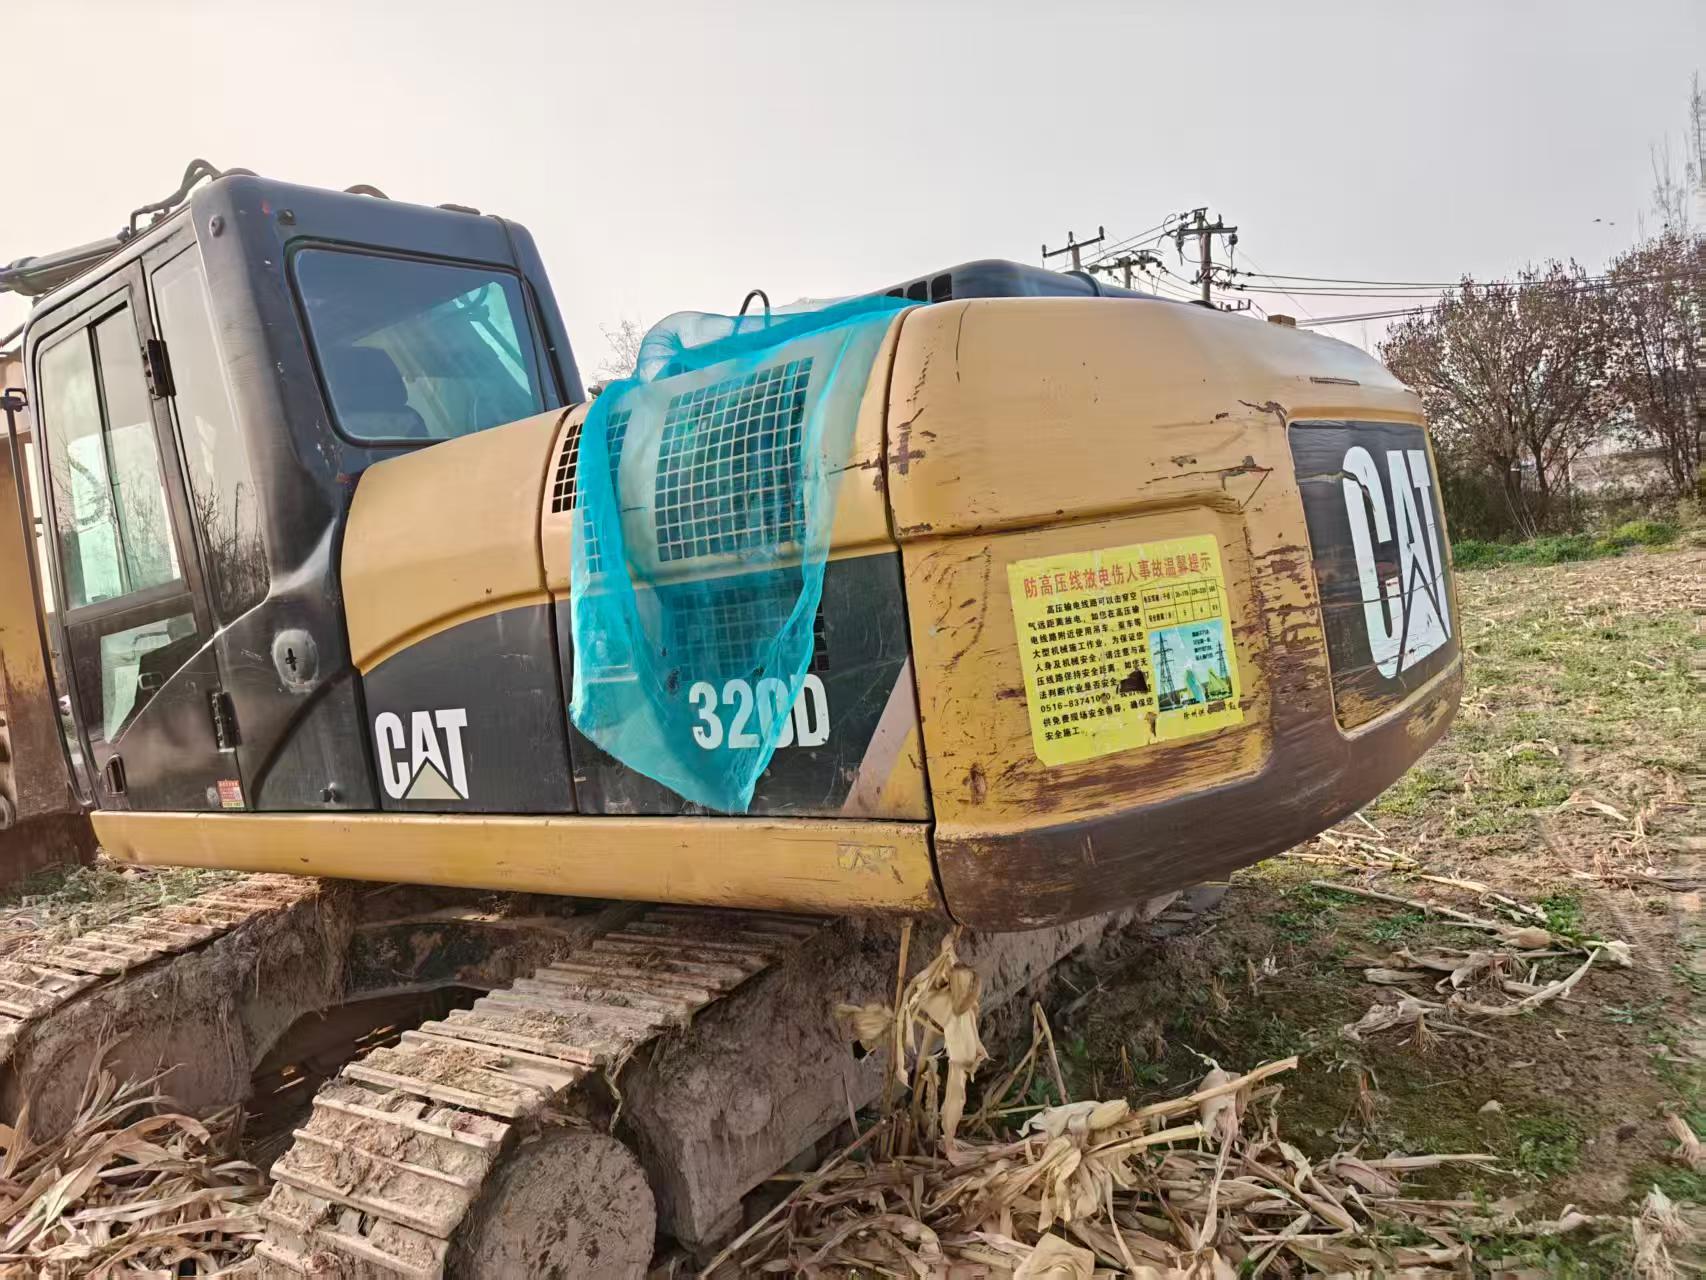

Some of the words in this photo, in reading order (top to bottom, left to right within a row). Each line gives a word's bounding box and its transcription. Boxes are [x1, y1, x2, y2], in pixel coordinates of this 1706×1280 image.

[1342, 446, 1451, 679] CAT
[374, 708, 469, 799] CAT
[688, 673, 830, 750] 320D
